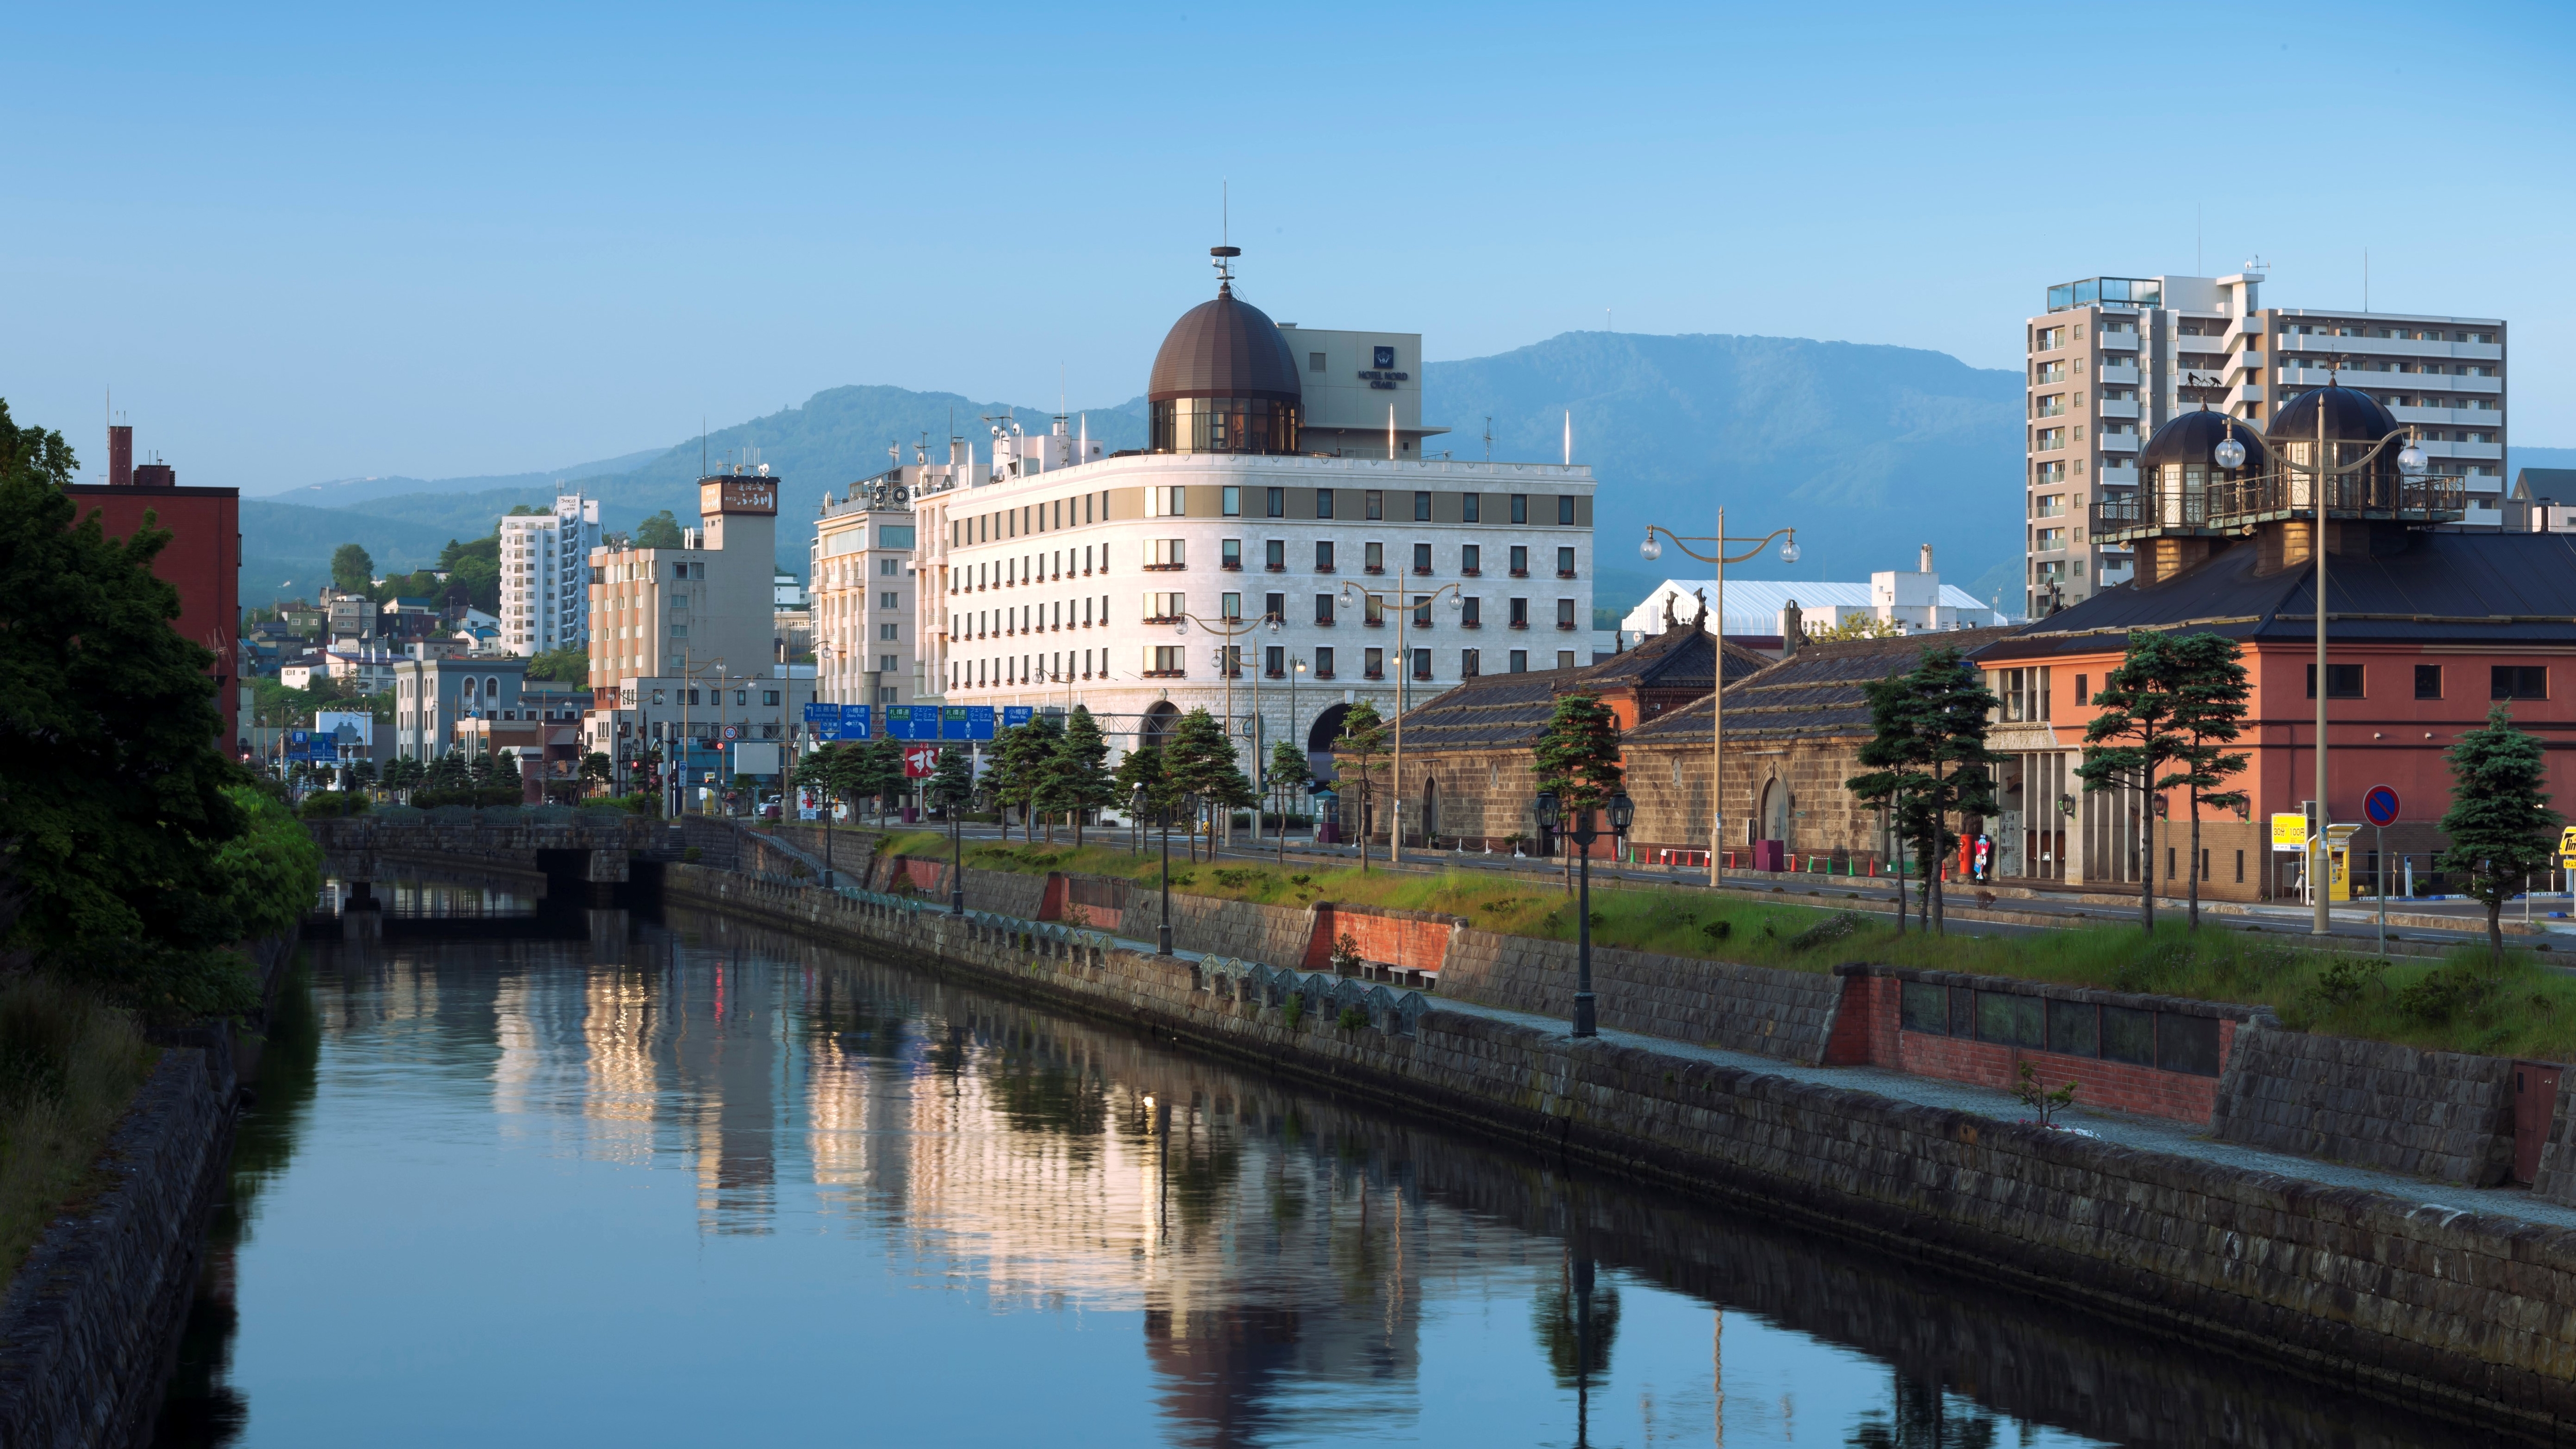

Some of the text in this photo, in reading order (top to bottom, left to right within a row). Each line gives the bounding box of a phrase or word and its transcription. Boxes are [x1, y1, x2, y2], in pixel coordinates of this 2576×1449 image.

[1359, 371, 1408, 380] HOTEL NORD
[1370, 381, 1396, 389] OTARU
[737, 491, 773, 509] ふる川
[908, 750, 938, 773] すし
